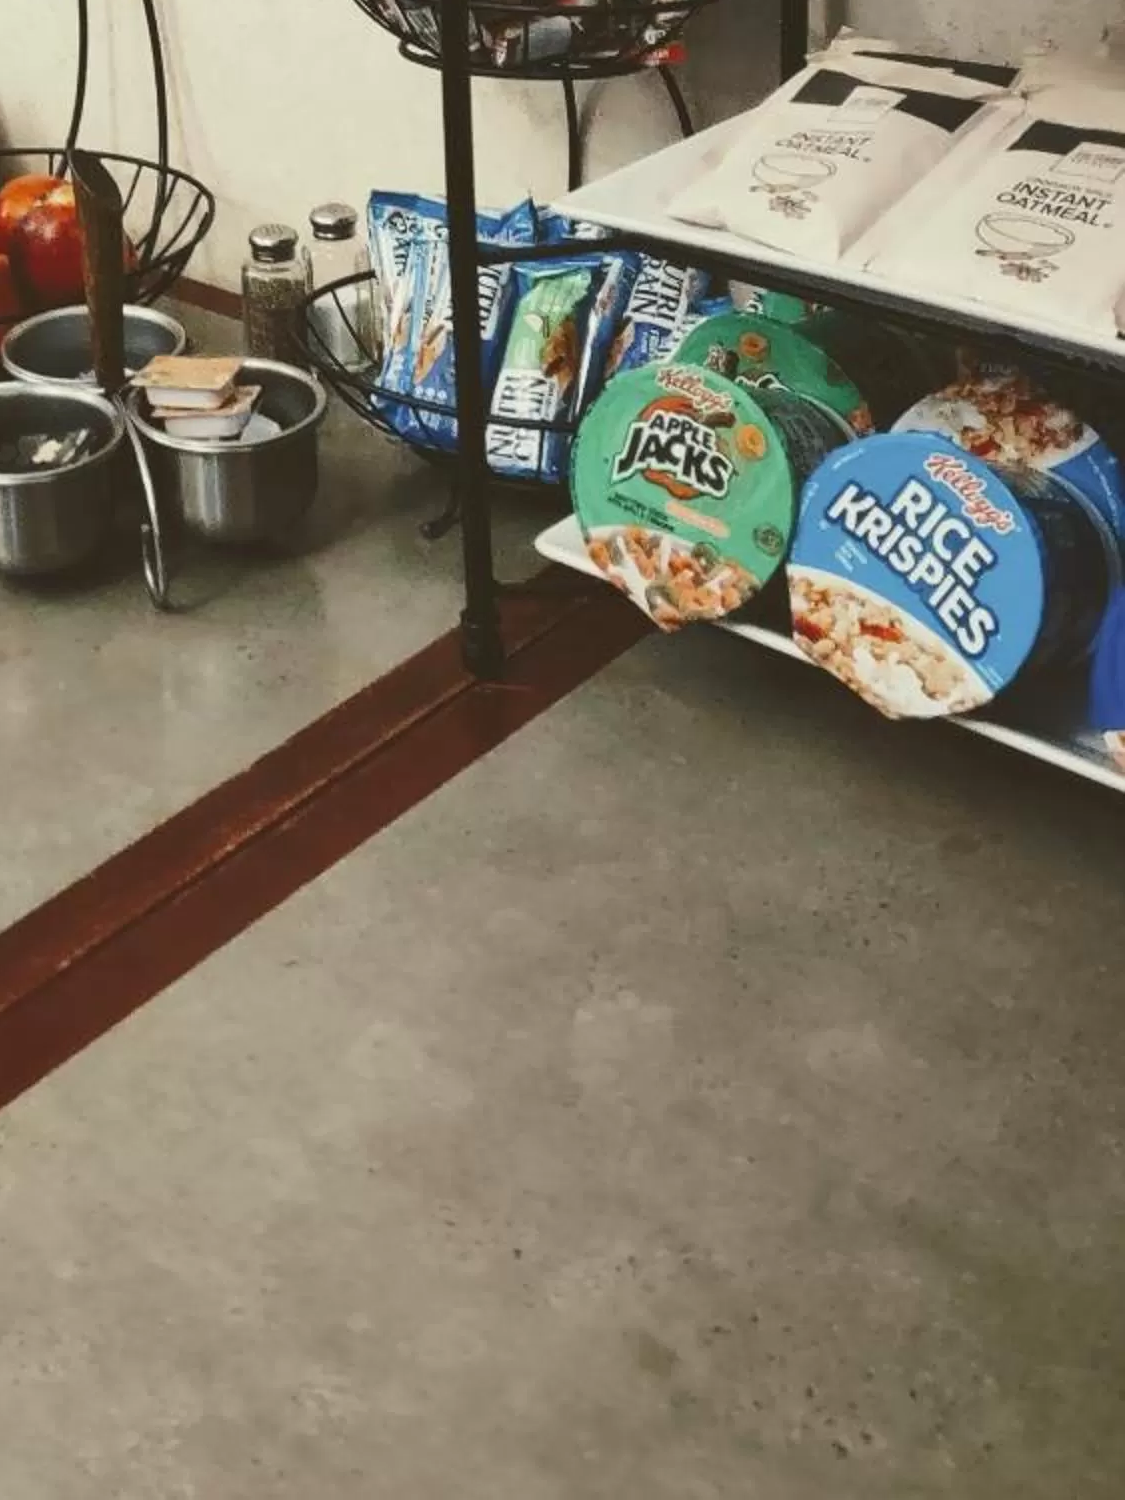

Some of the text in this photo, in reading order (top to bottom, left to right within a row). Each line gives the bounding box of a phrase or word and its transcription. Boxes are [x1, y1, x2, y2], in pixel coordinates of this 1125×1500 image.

[995, 191, 1100, 227] OATMEAL
[1012, 181, 1112, 211] INSTANT
[654, 263, 686, 321] UTRI
[617, 427, 729, 491] JACKS
[649, 414, 715, 451] APPLE
[924, 453, 1014, 534] Kellogg's
[890, 478, 995, 588] RICE
[828, 483, 996, 655] KRISPIES
